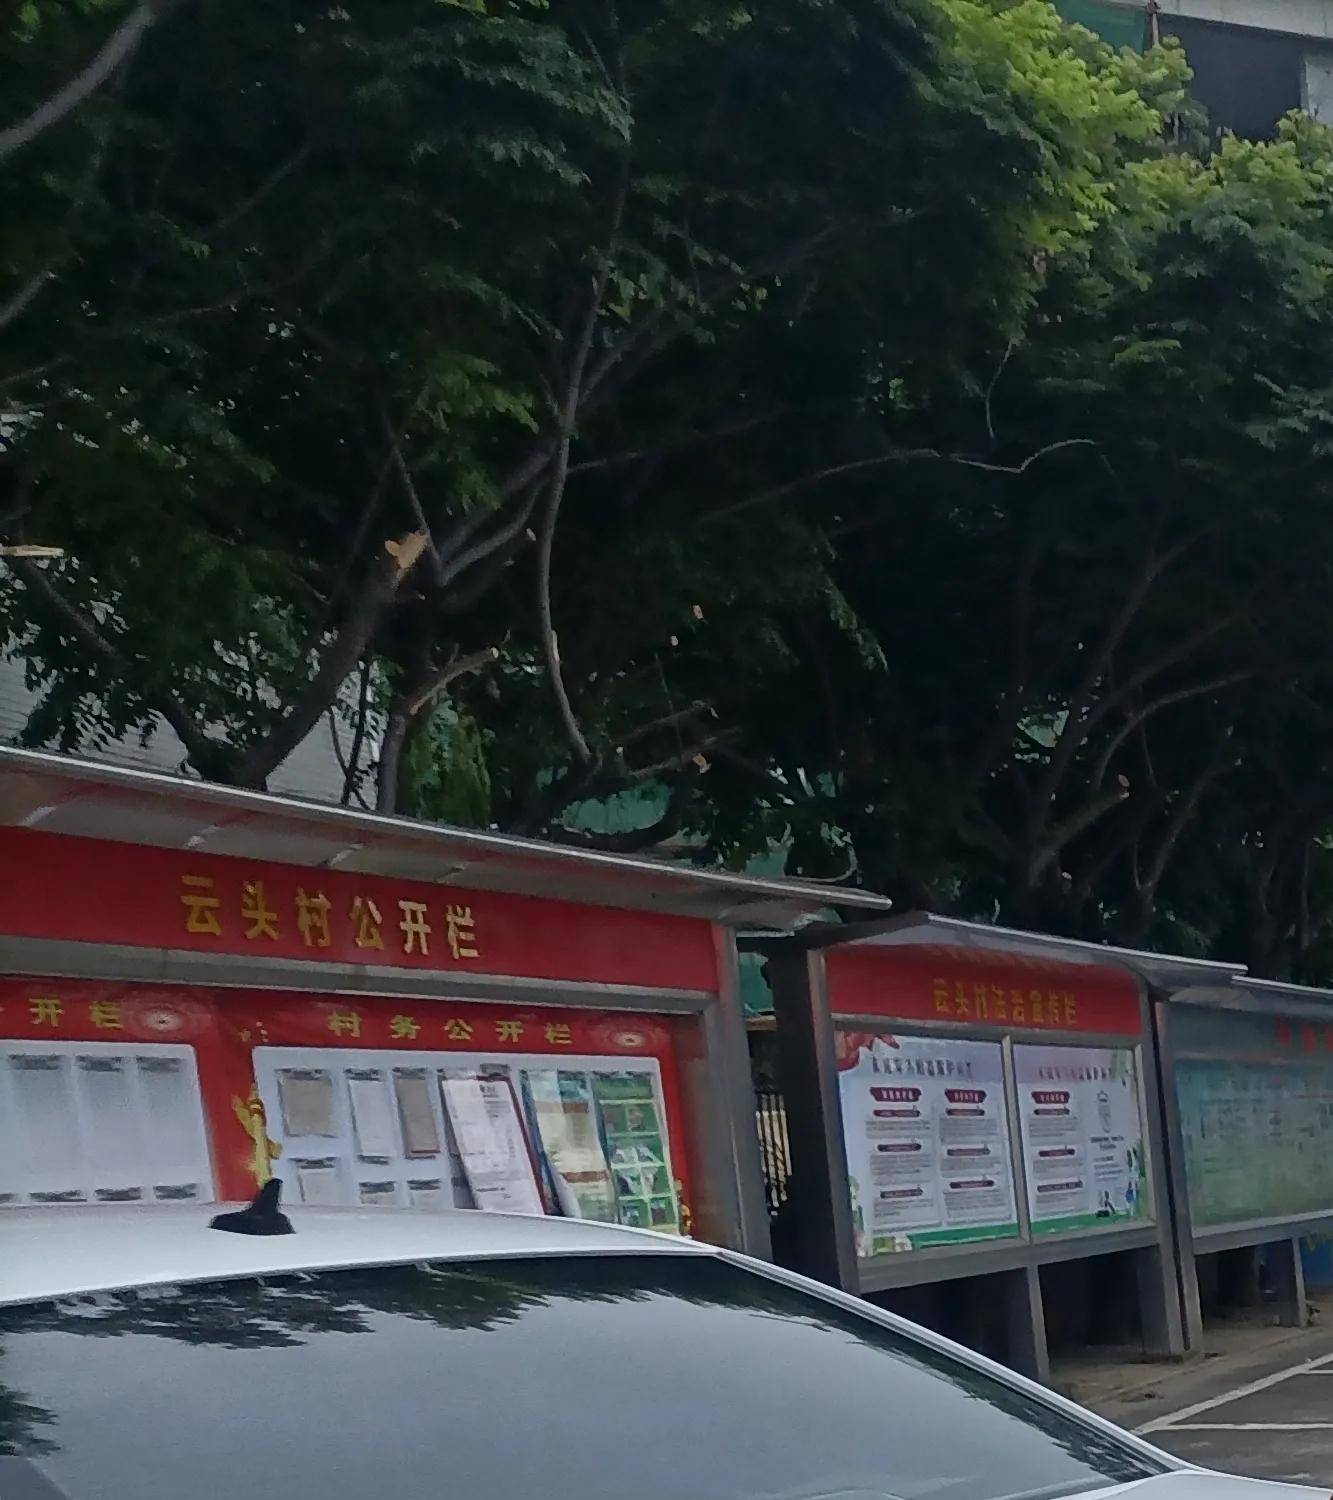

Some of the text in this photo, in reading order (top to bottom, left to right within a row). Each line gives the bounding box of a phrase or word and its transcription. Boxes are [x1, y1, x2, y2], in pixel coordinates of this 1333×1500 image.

[181, 875, 480, 959] 云头村公开栏
[0, 998, 124, 1030] 开栏
